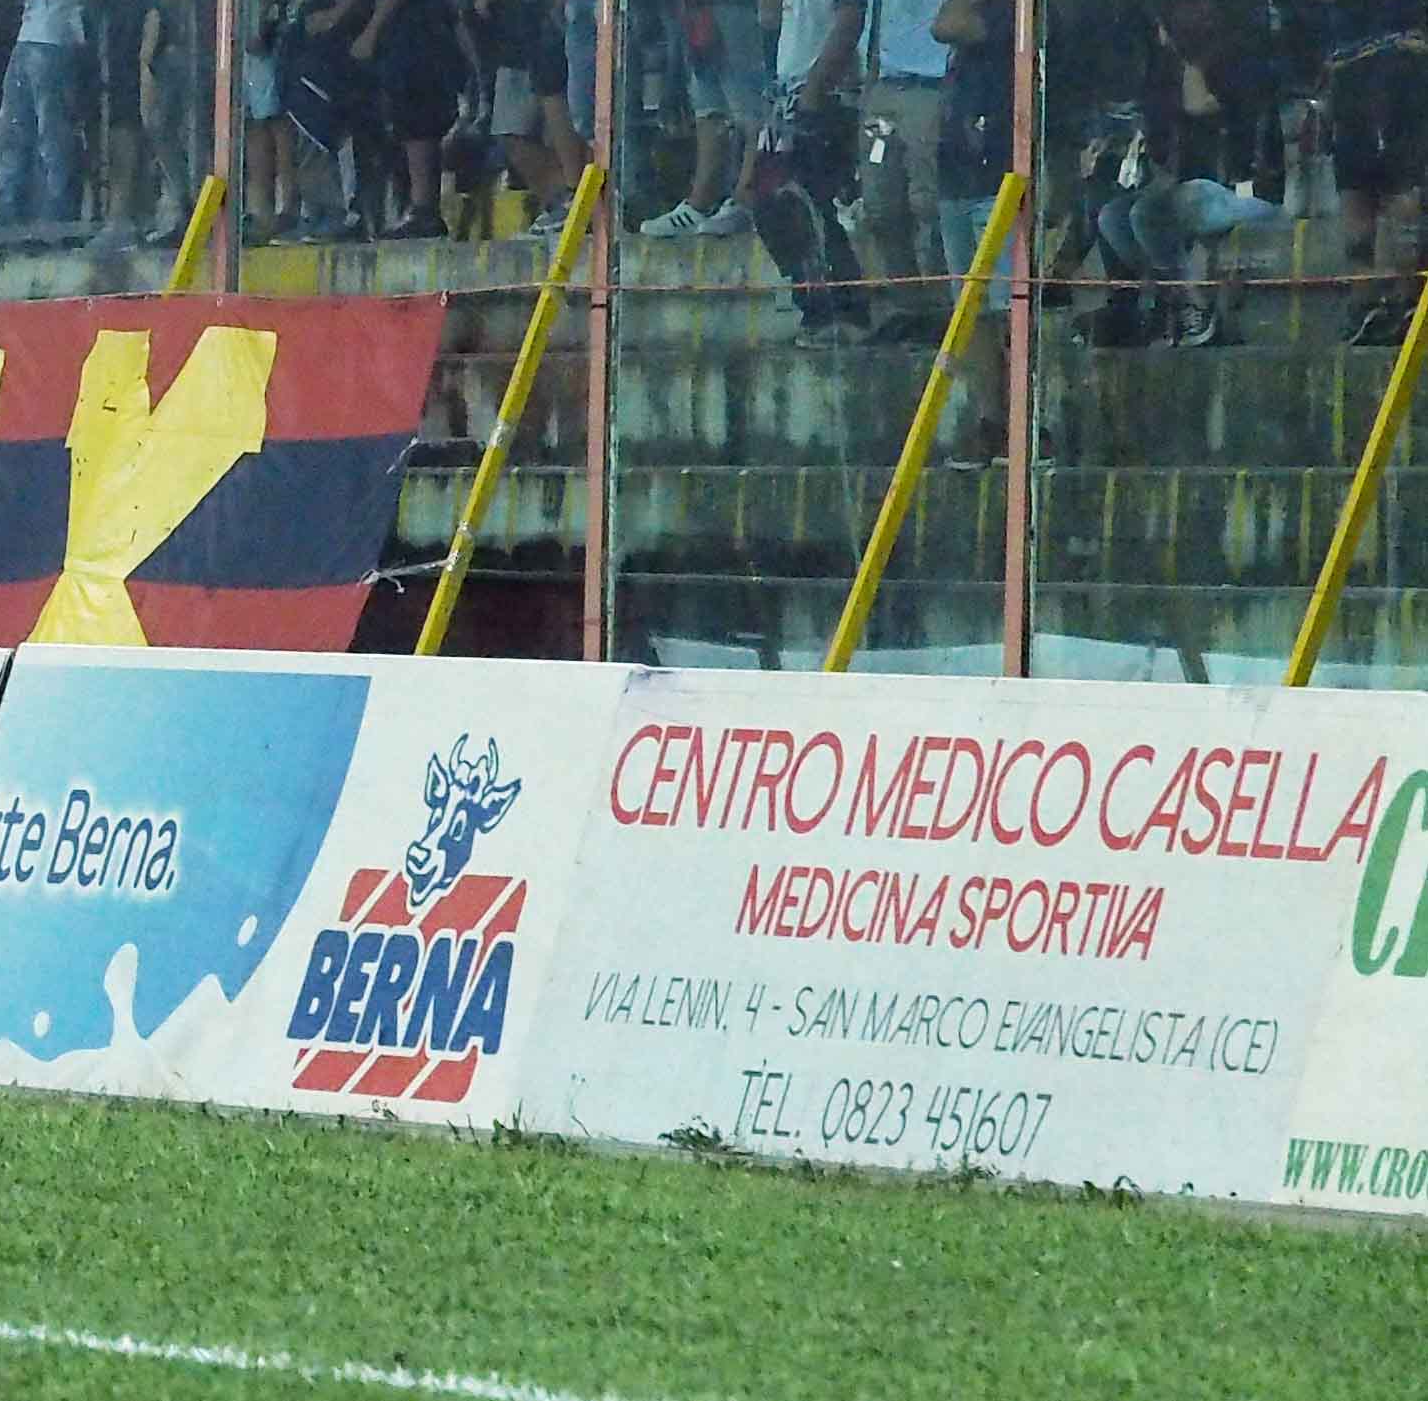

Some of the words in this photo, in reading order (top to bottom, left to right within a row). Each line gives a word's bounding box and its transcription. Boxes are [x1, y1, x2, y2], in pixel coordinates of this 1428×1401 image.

[47, 788, 179, 892] Berna.
[610, 722, 844, 835] CENTRO
[845, 733, 1092, 847] MEDICO
[1099, 743, 1388, 865] CASELLA
[734, 863, 950, 945] MEDICINA
[948, 877, 1166, 962] SPORTIVA
[285, 928, 517, 1058] BERNA
[583, 971, 639, 1025] VIA
[745, 983, 767, 1033] 4
[788, 986, 858, 1041] SAN
[860, 992, 992, 1050] MARCO
[995, 1001, 1208, 1069] EVANGELISTA
[1209, 1014, 1280, 1076] (CE)
[733, 1066, 801, 1139] TEL.
[821, 1075, 913, 1148] 0823
[923, 1086, 1053, 1159] 451607
[1282, 1138, 1428, 1200] WWW.CRO
